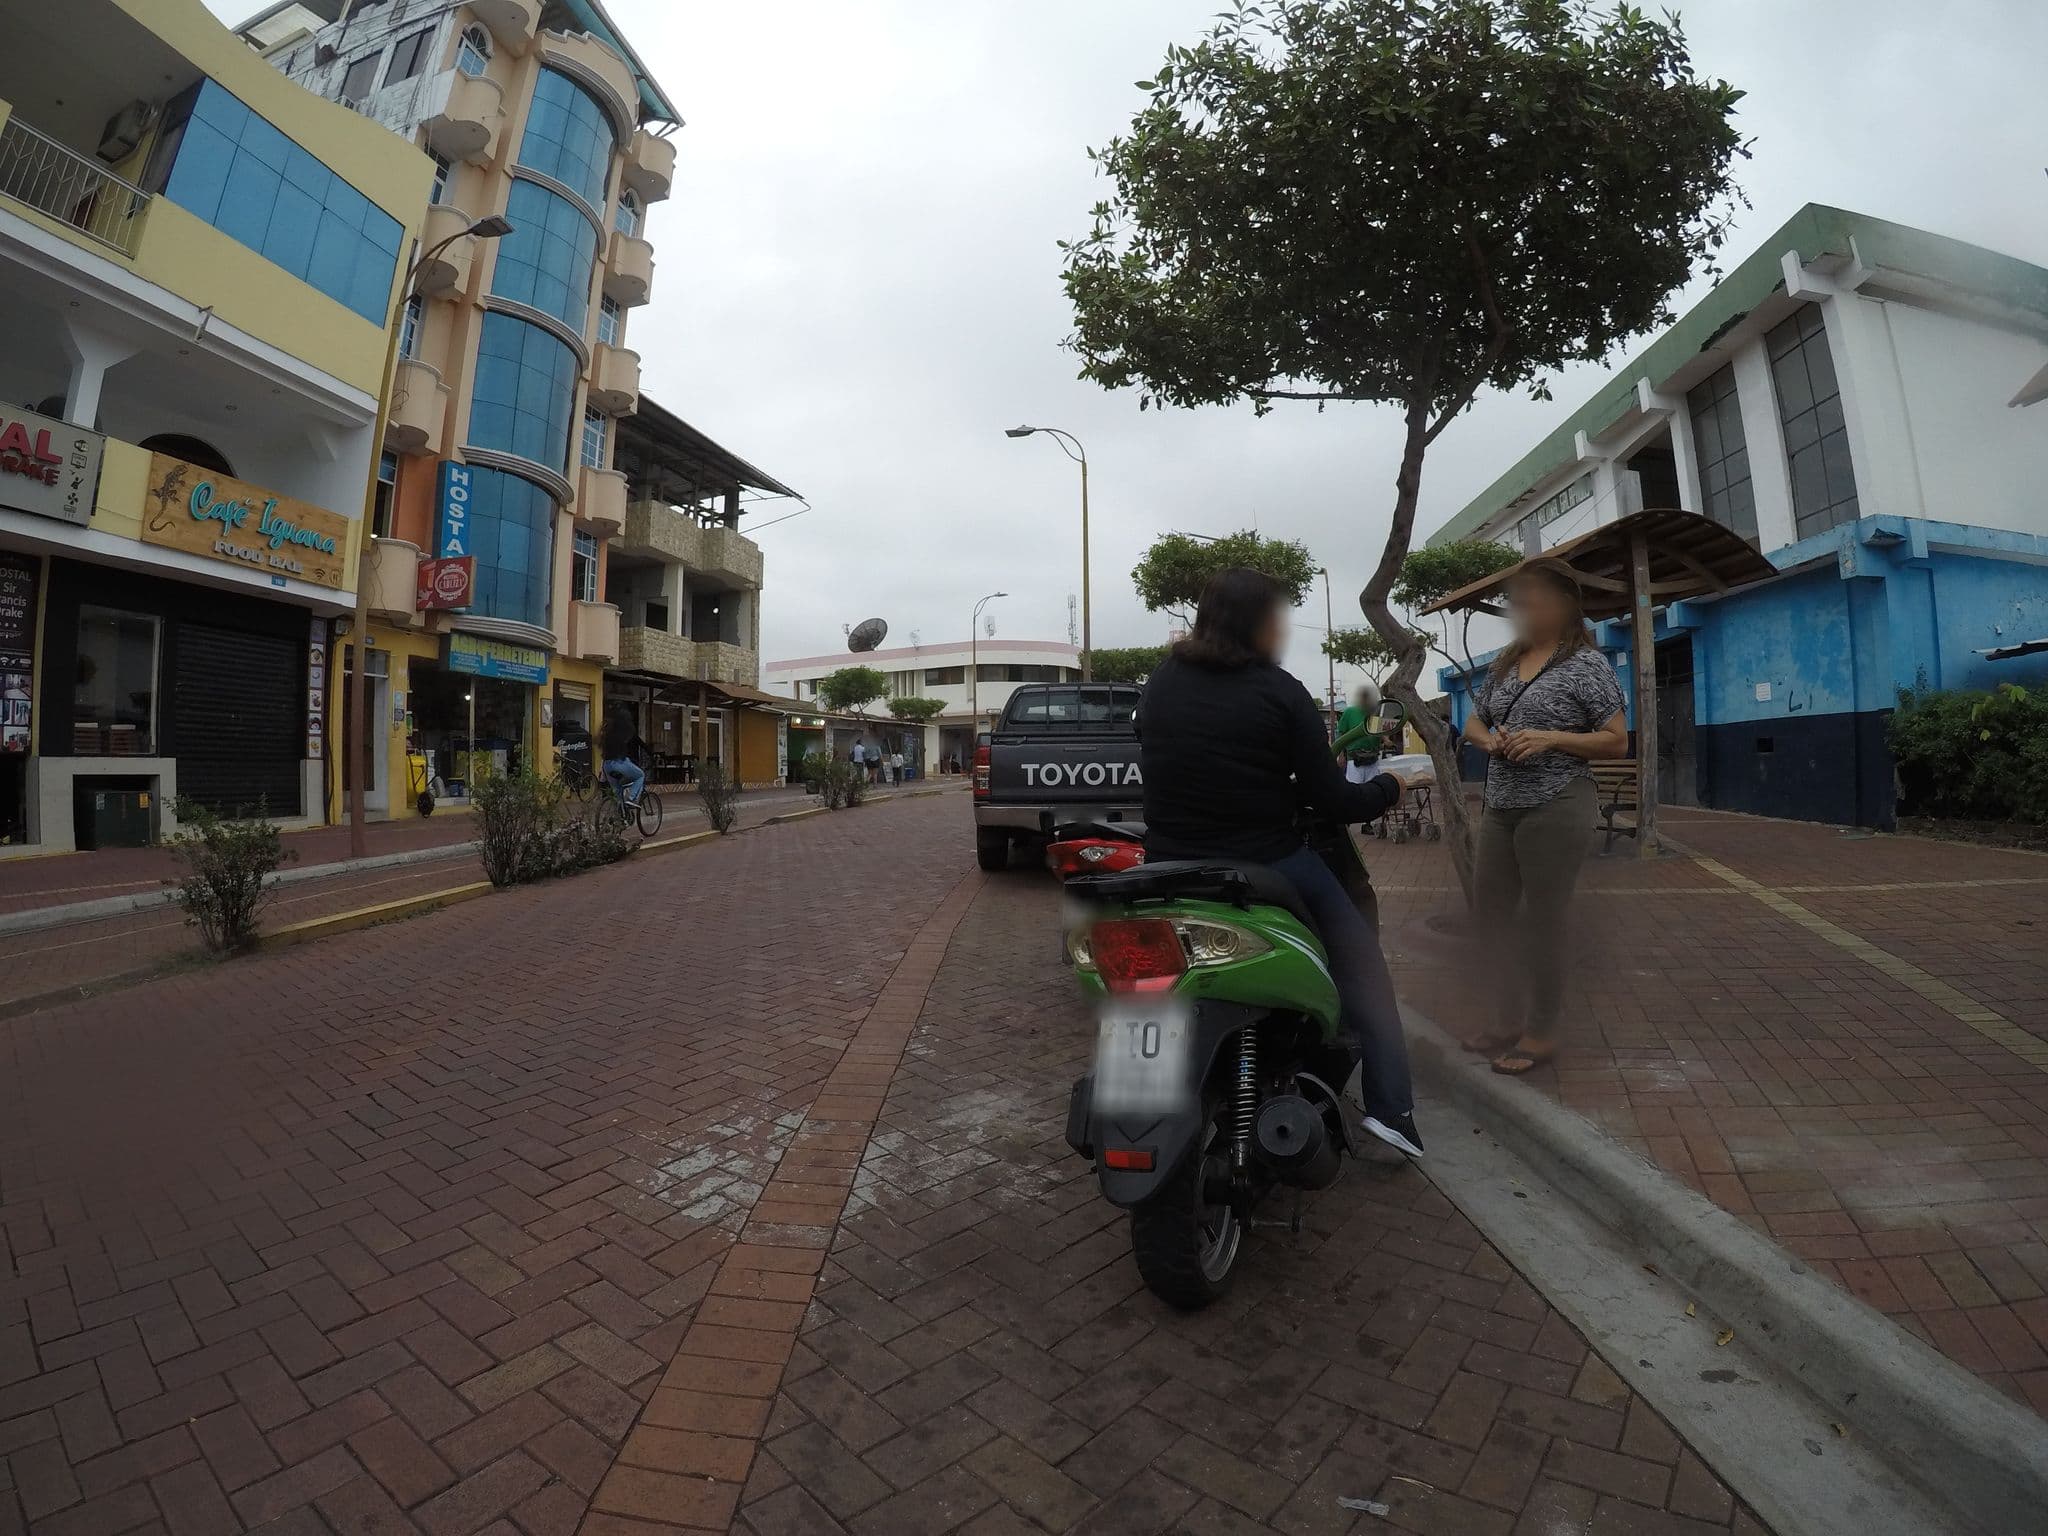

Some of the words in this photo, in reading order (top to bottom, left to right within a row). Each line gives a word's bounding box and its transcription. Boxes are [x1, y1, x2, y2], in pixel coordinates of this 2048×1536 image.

[0, 418, 63, 465] AL
[190, 481, 251, 537] Café
[257, 498, 337, 555] Iguana
[446, 468, 469, 559] HOSTA
[214, 540, 264, 563] FOOD
[3, 581, 17, 593] Sir
[0, 595, 27, 607] ancis
[0, 606, 24, 618] rake
[1021, 763, 1143, 786] TOYOTA
